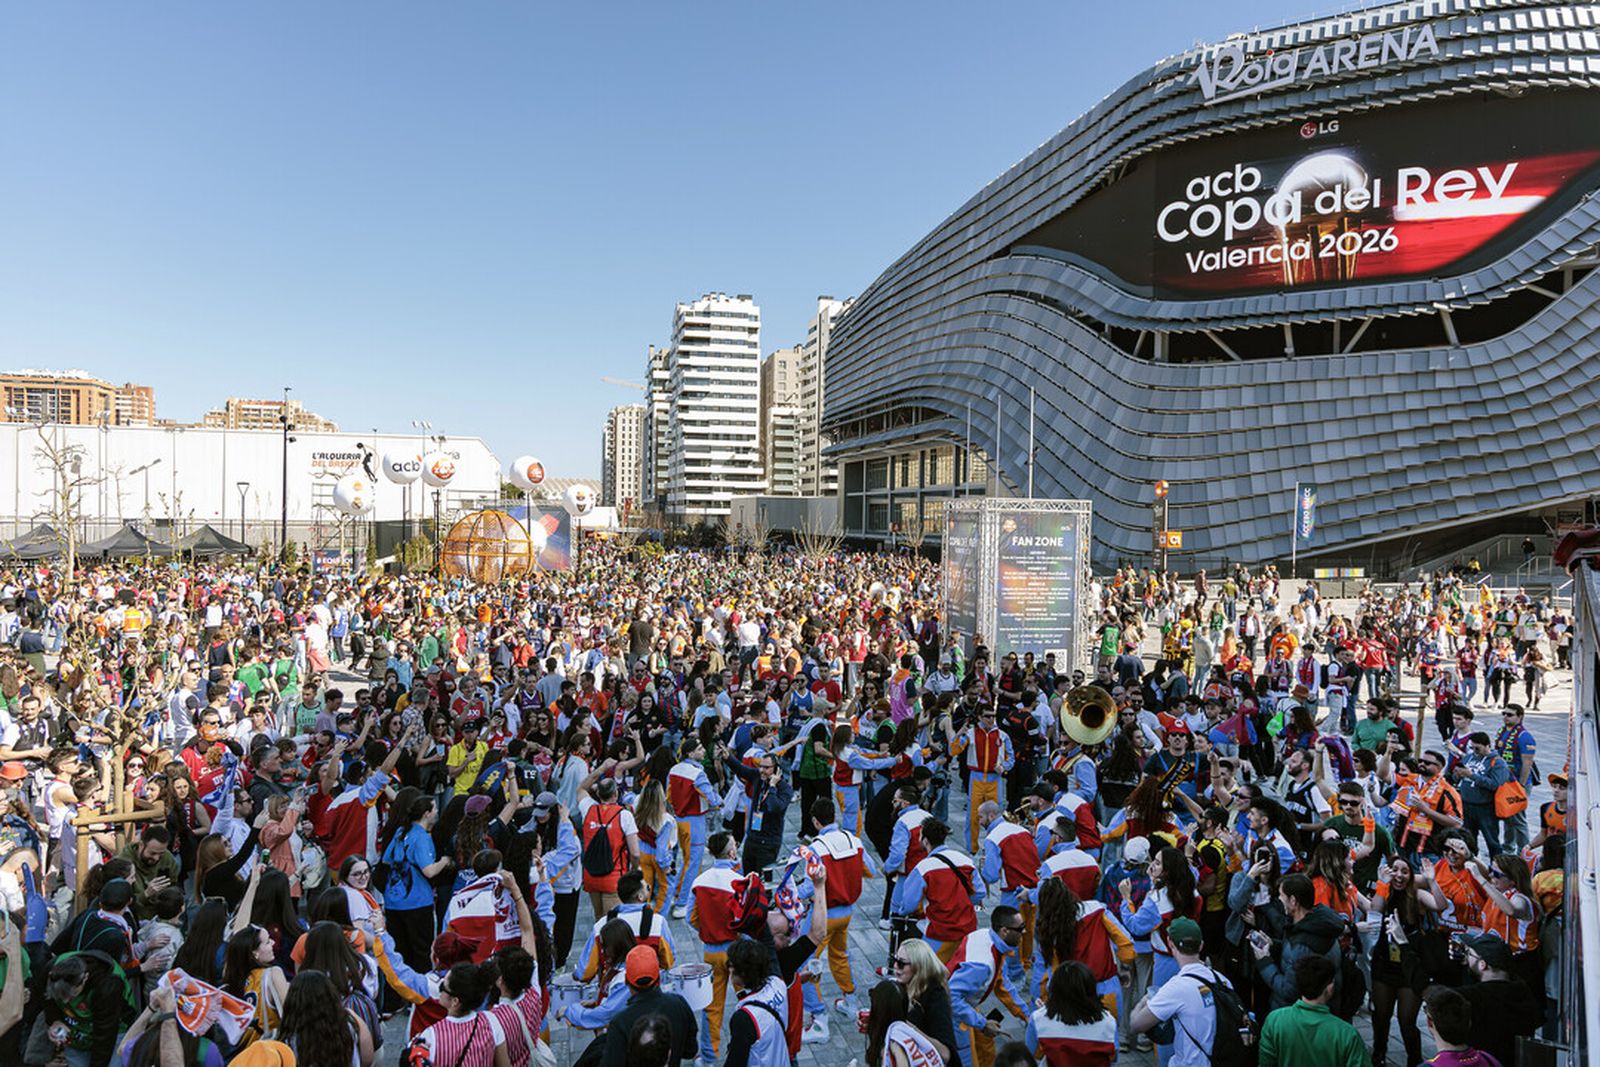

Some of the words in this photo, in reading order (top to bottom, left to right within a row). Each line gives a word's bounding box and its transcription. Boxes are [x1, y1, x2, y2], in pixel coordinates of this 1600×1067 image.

[1302, 25, 1440, 80] ARENA
[1319, 120, 1340, 135] LG
[1185, 163, 1261, 202] acb
[1156, 189, 1302, 243] Copa
[1314, 178, 1381, 215] del
[1396, 162, 1519, 212] Rey
[1185, 238, 1311, 273] Valencia
[1318, 227, 1399, 258] 2026
[312, 452, 361, 460] L'ALQUERIA
[391, 461, 420, 472] acb
[1012, 536, 1033, 546] FAN
[1035, 536, 1064, 547] ZONE
